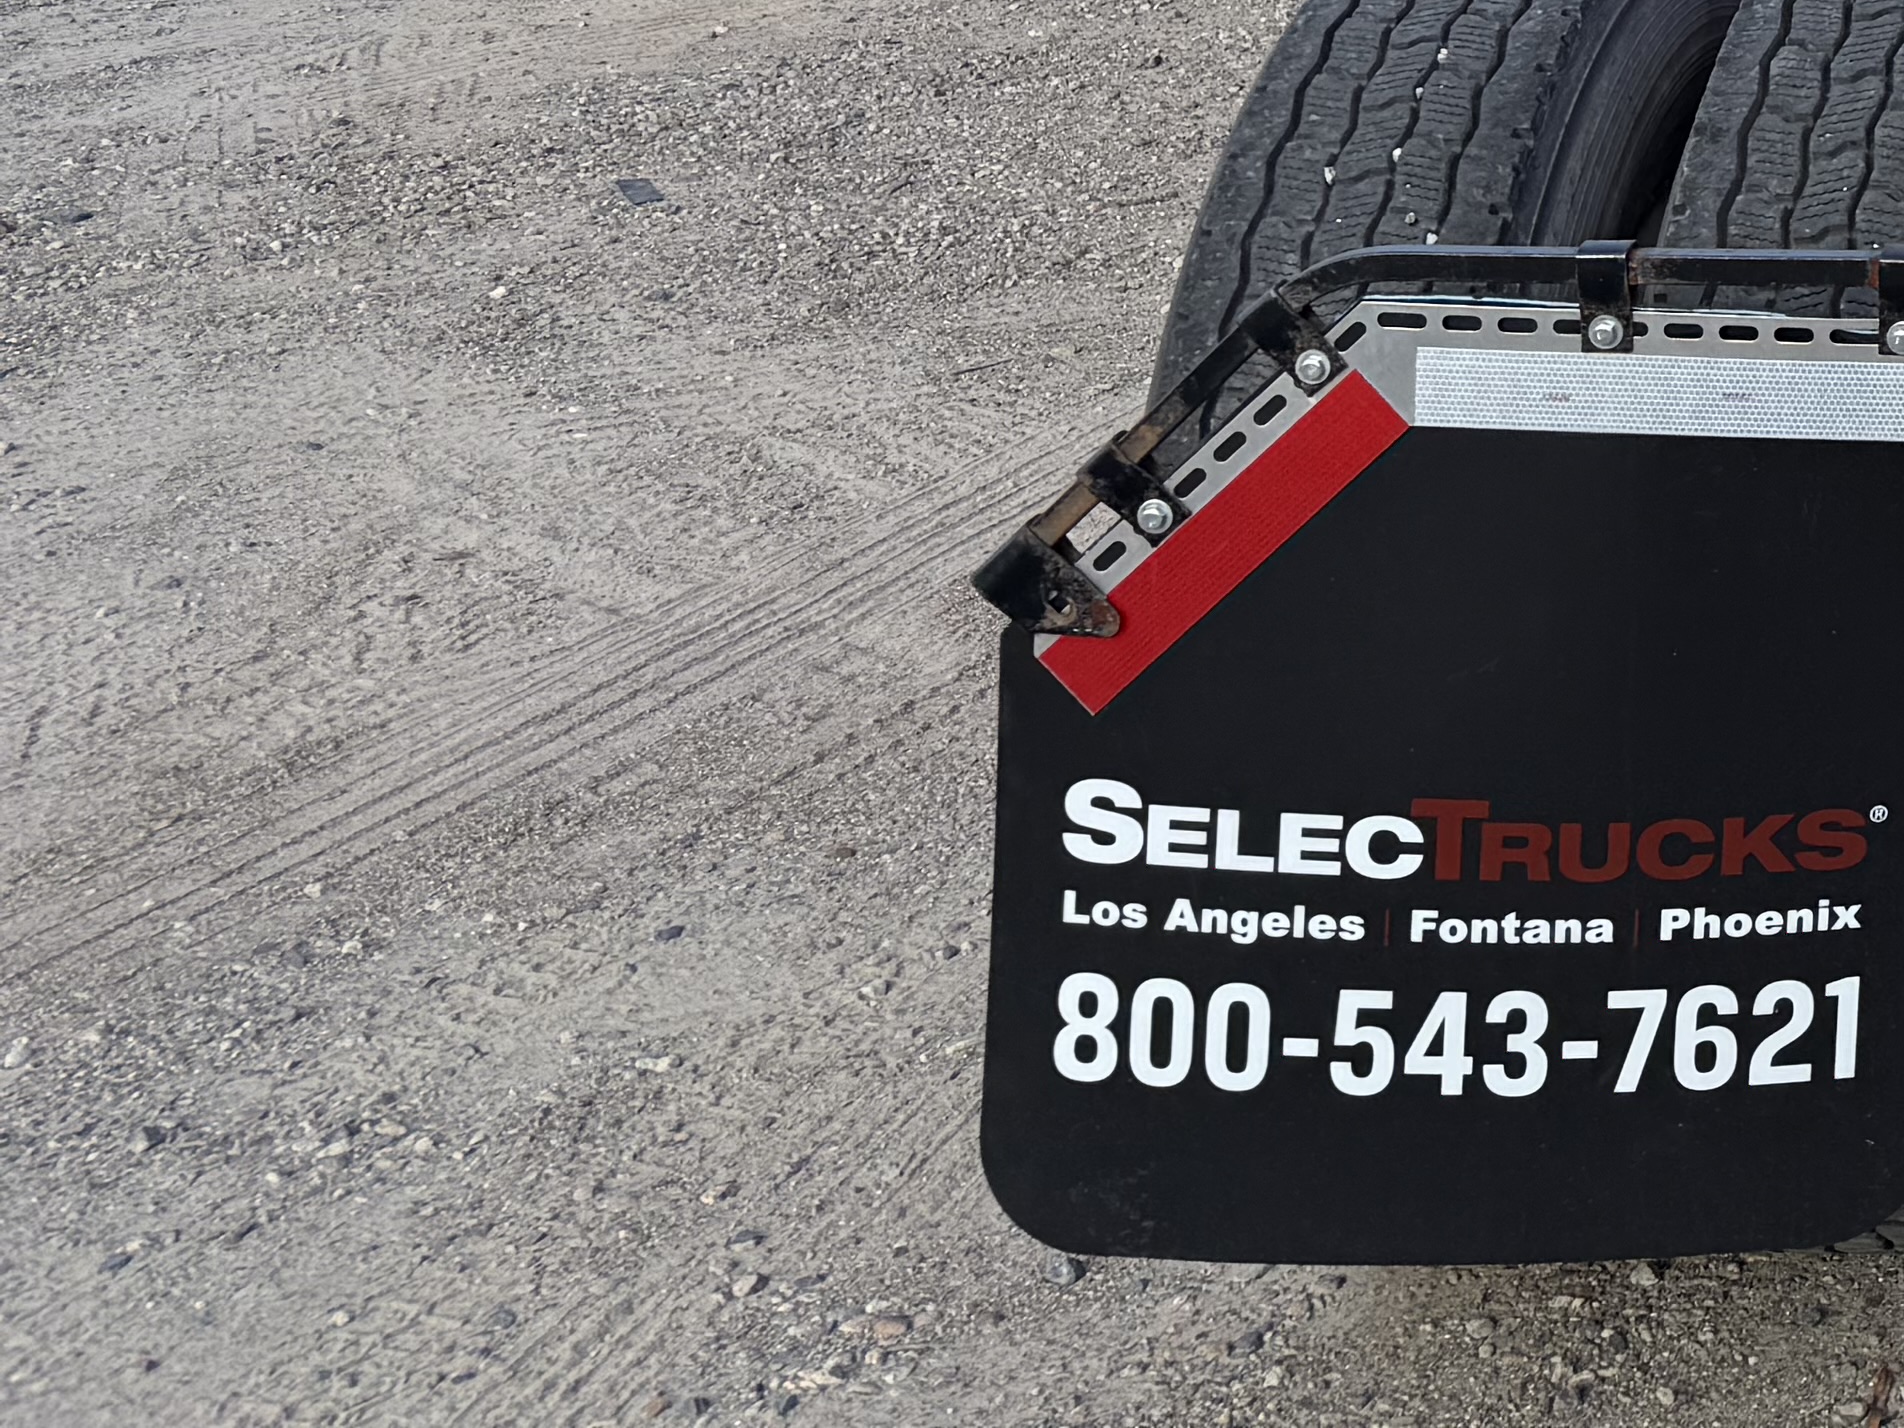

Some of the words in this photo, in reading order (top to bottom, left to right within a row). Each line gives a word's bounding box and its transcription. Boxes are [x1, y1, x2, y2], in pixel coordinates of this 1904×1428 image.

[1061, 889, 1149, 930] Los
[1163, 897, 1366, 945] Angeles
[1409, 909, 1614, 945] Fontana
[1659, 898, 1862, 942] Phoenix
[1052, 971, 1861, 1098] 800-543-7621
